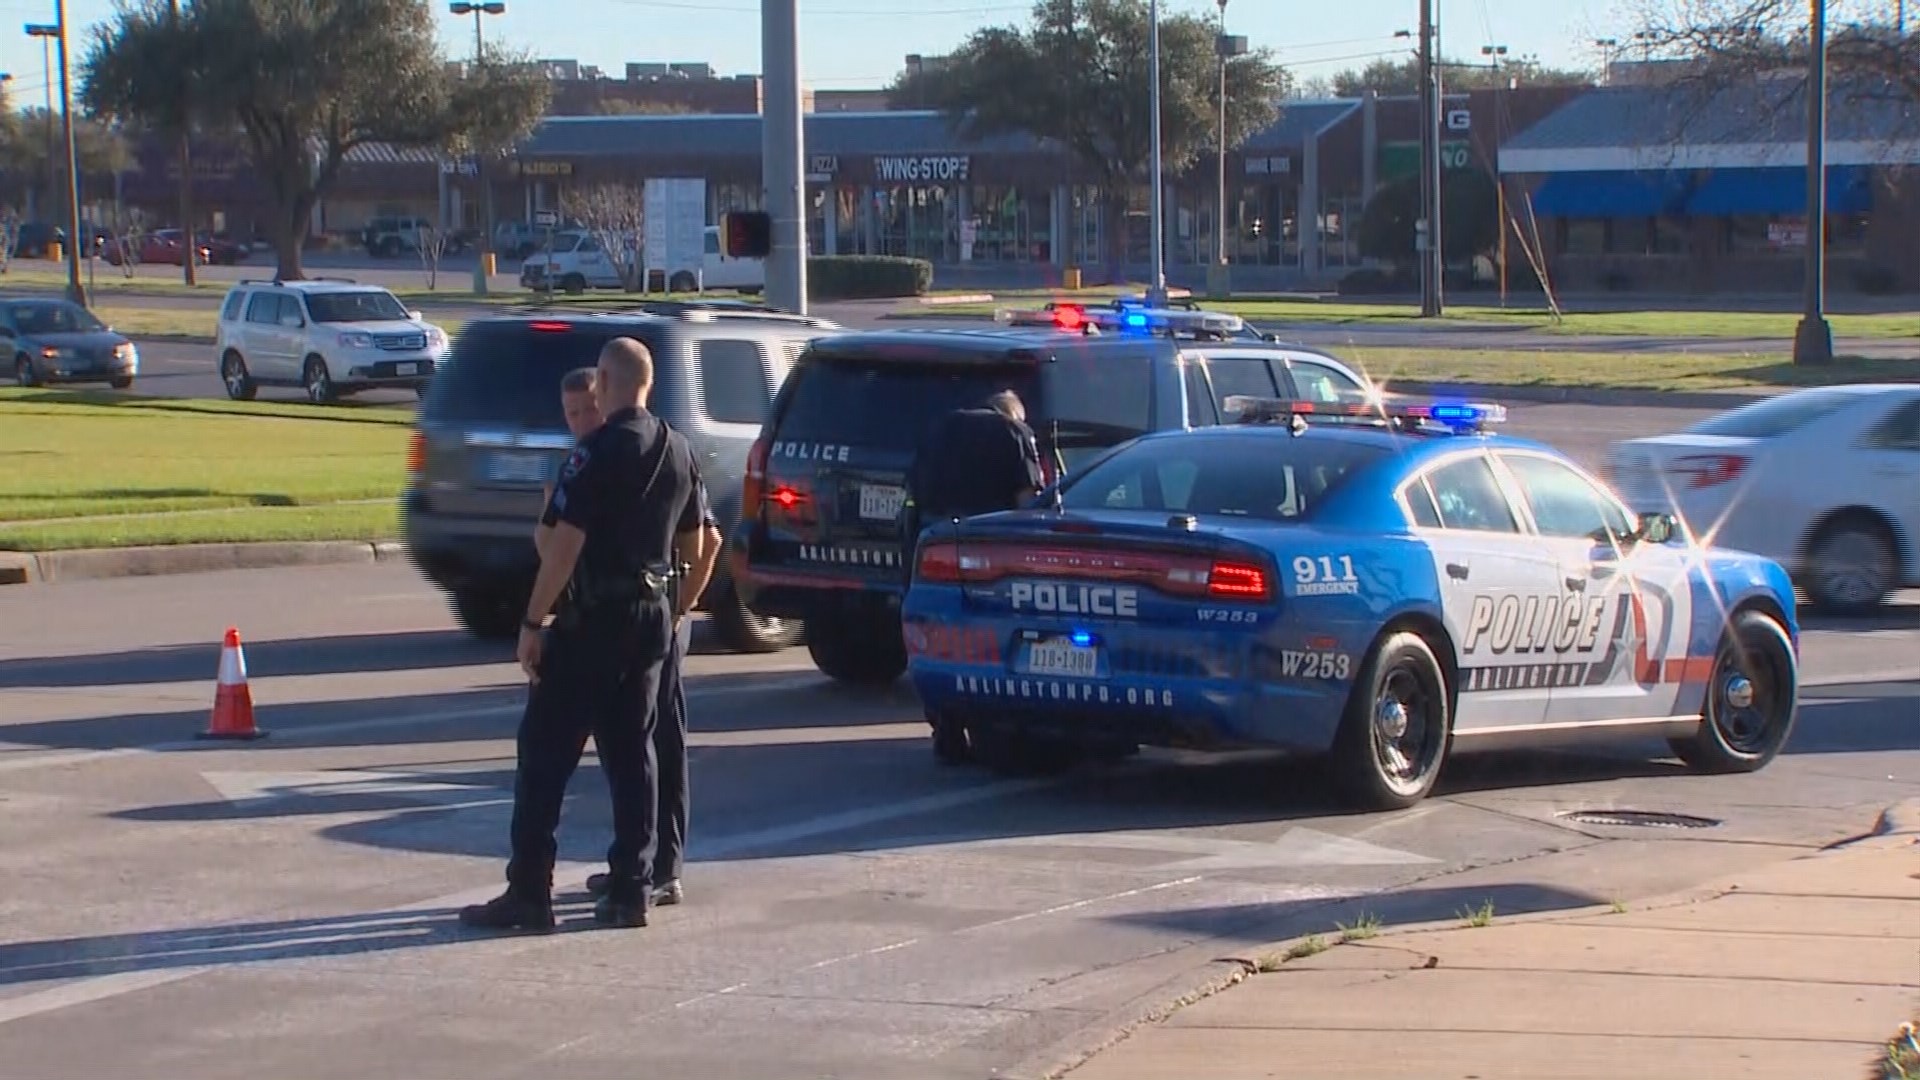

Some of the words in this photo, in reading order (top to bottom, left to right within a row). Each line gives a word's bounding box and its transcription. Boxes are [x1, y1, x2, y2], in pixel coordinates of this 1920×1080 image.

[771, 442, 850, 463] POLICE
[1293, 556, 1358, 583] 911
[1012, 582, 1138, 617] POLICE
[1296, 582, 1359, 595] EMERGENCY
[1197, 609, 1258, 623] W253
[1464, 594, 1604, 655] POLICE
[1281, 651, 1350, 679] W253
[1469, 664, 1582, 691] ARLINGTON
[955, 676, 1174, 707] ARLINGTONPD.ORG
